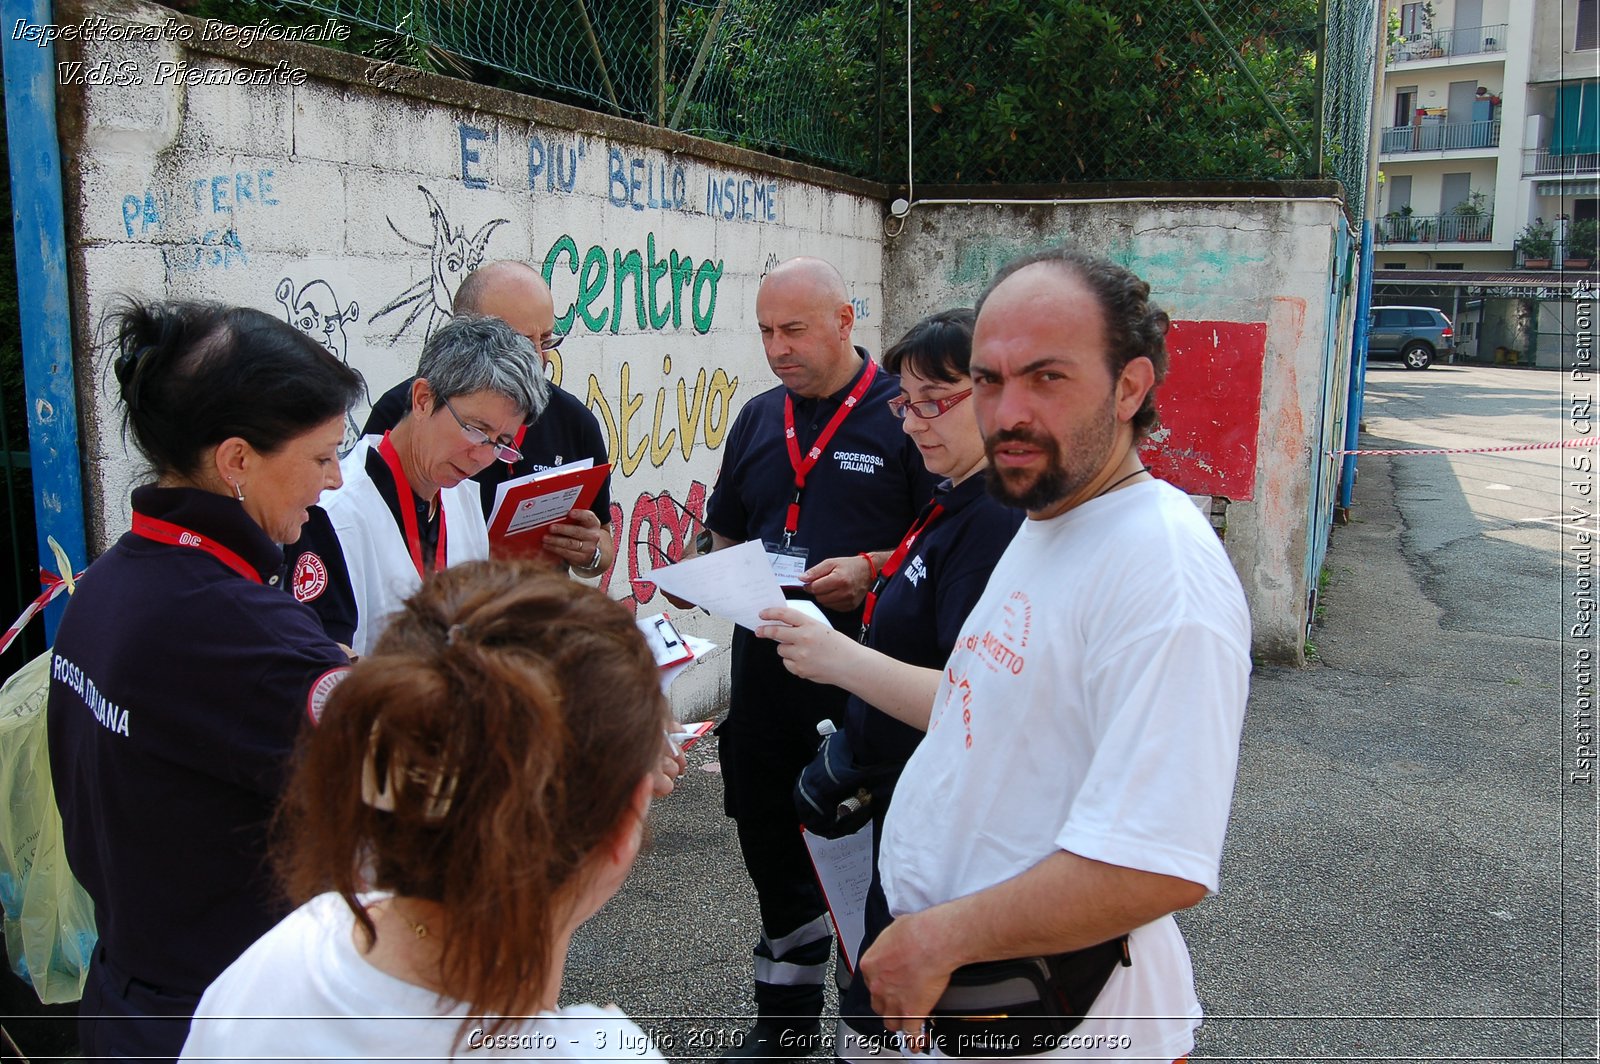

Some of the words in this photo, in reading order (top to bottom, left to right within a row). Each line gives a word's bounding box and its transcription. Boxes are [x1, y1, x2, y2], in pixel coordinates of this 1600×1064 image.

[607, 146, 689, 212] BELLO
[706, 172, 778, 222] INSIEME
[541, 231, 724, 336] Centro
[833, 451, 860, 461] CROCE
[860, 454, 884, 467] ROSSA
[840, 461, 874, 474] ITALIANA
[54, 654, 84, 698] ROSSA
[85, 678, 129, 737] ITALIANA
